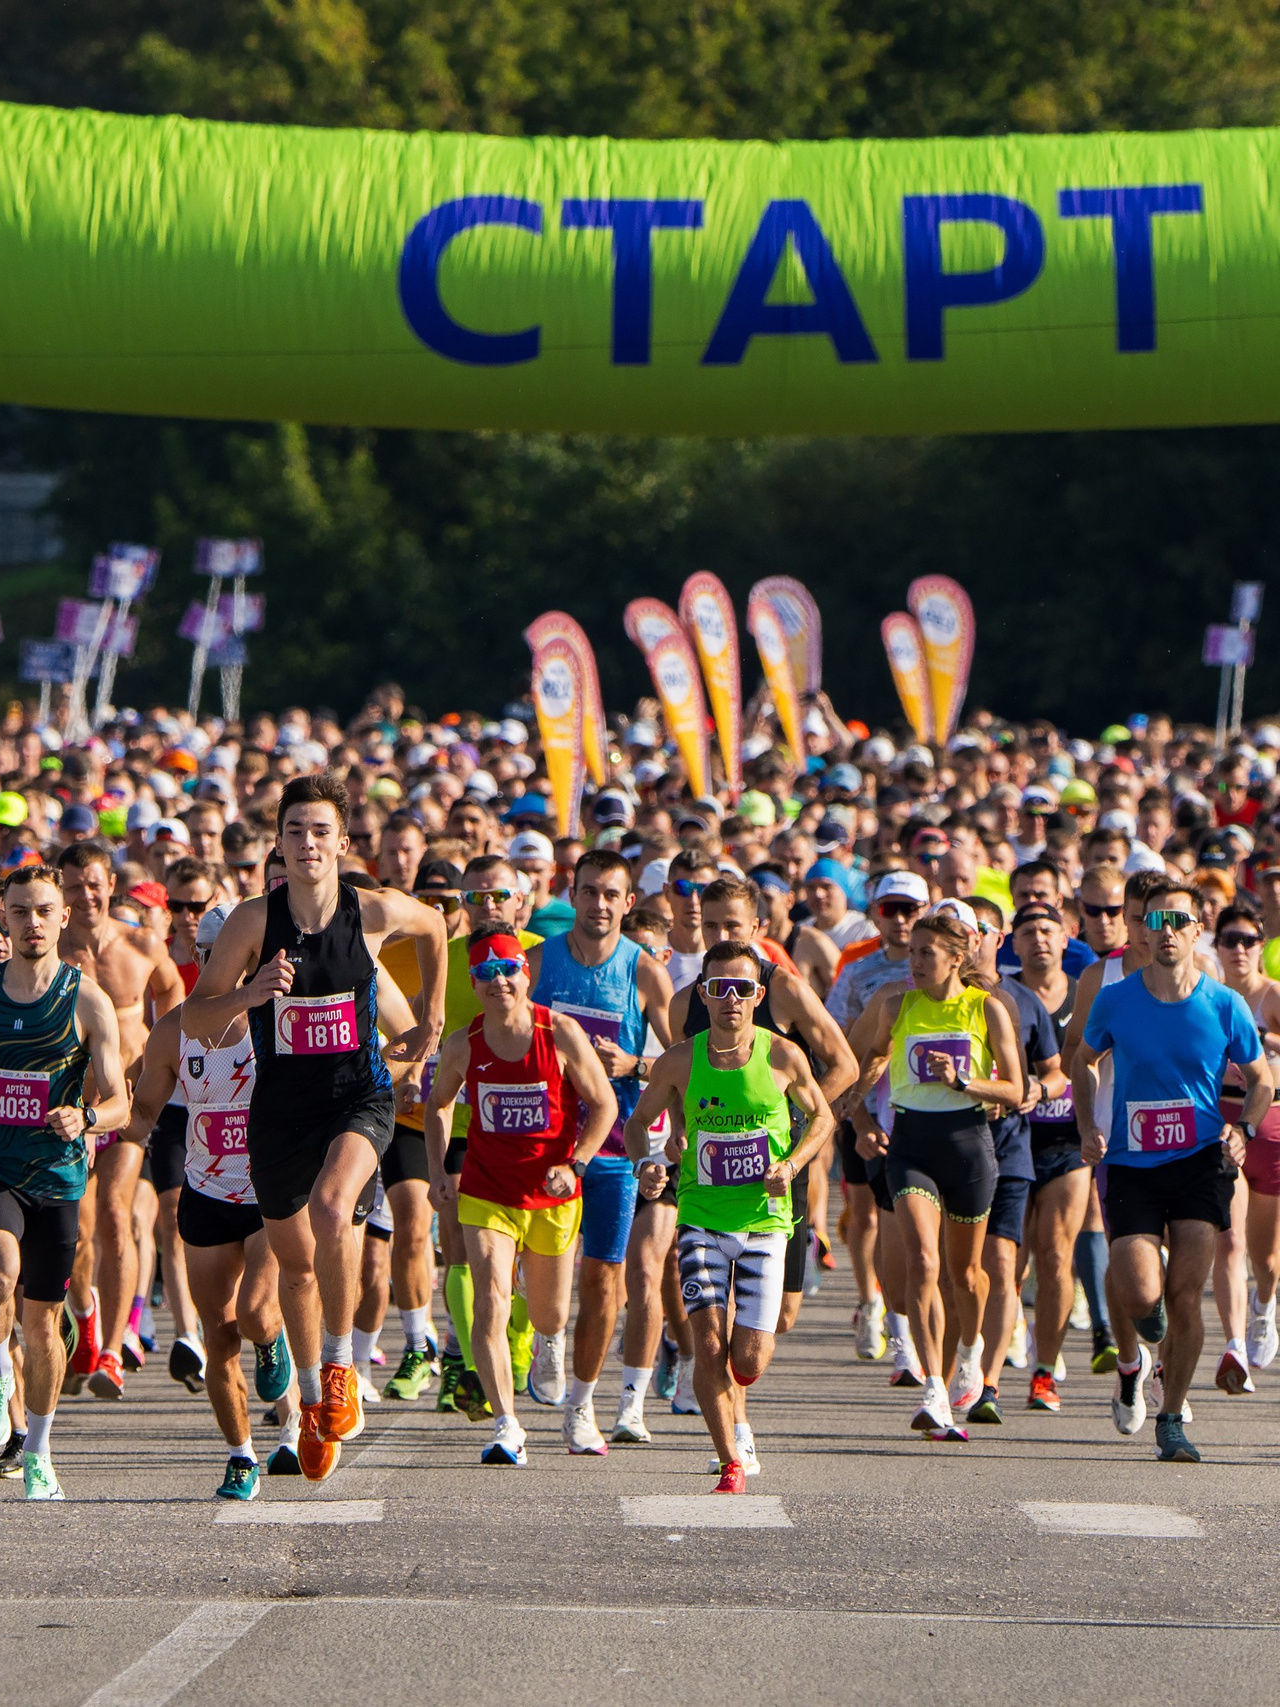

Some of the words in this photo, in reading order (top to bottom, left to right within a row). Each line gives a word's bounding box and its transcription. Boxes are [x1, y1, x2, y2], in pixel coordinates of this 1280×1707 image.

[396, 182, 1204, 367] СТАРТ
[308, 1009, 342, 1022] КИРИЛЛ
[305, 1021, 351, 1048] 1818
[500, 1096, 544, 1106] АЛЕКСАНДР
[1036, 1099, 1071, 1117] 5202
[502, 1108, 545, 1128] 2734
[695, 1114, 771, 1127] К-ХОЛДИНГ
[1157, 1112, 1180, 1123] ПАВЕЛ
[1154, 1123, 1186, 1146] 370
[724, 1142, 758, 1157] АЛЕКСЕЙ
[722, 1154, 765, 1180] 1283
